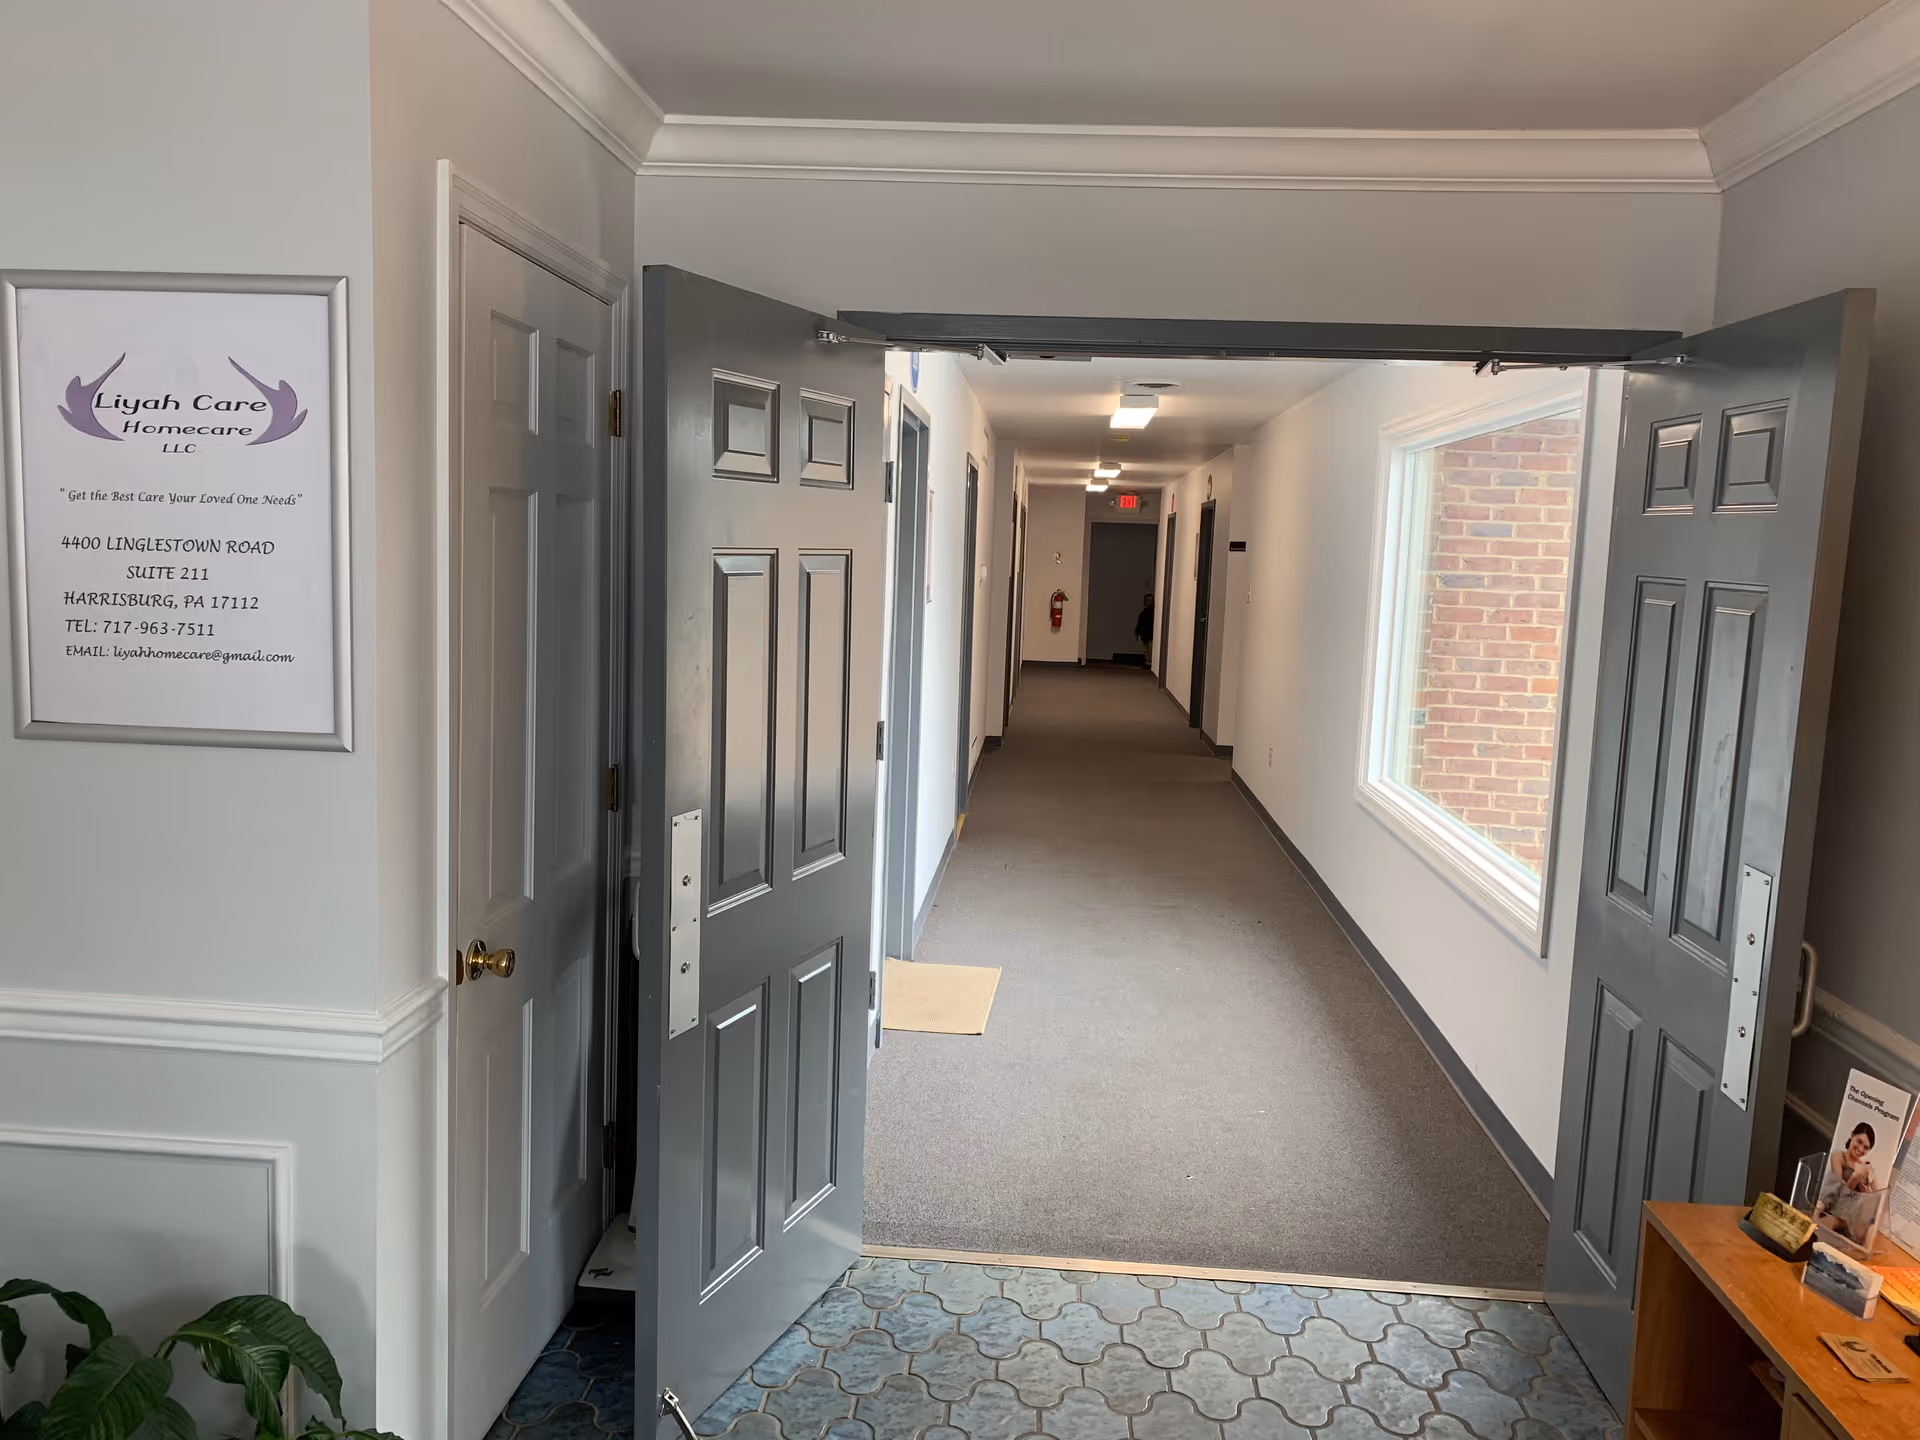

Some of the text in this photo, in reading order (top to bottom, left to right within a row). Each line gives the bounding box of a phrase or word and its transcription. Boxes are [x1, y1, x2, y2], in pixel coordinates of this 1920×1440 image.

[94, 392, 267, 416] Liyah Care
[122, 419, 253, 437] Homecare
[161, 443, 197, 454] LLC
[90, 489, 108, 501] the
[110, 491, 135, 502] Best
[137, 491, 165, 503] Care
[167, 492, 197, 505] Your
[198, 492, 235, 505] Loved
[236, 493, 259, 505] One
[1120, 495, 1137, 508] EXIT
[60, 535, 275, 555] 4400 LINGLESTOWN ROAD
[125, 565, 209, 581] SUITE 211
[62, 590, 259, 610] HARRISBURG, PA 17112
[64, 618, 215, 637] TEL: 717-963-7511
[65, 644, 296, 665] EMAIL: liyahhomecare@gmail.com
[1850, 1085, 1885, 1107] The Opening
[1874, 1106, 1900, 1122] Program
